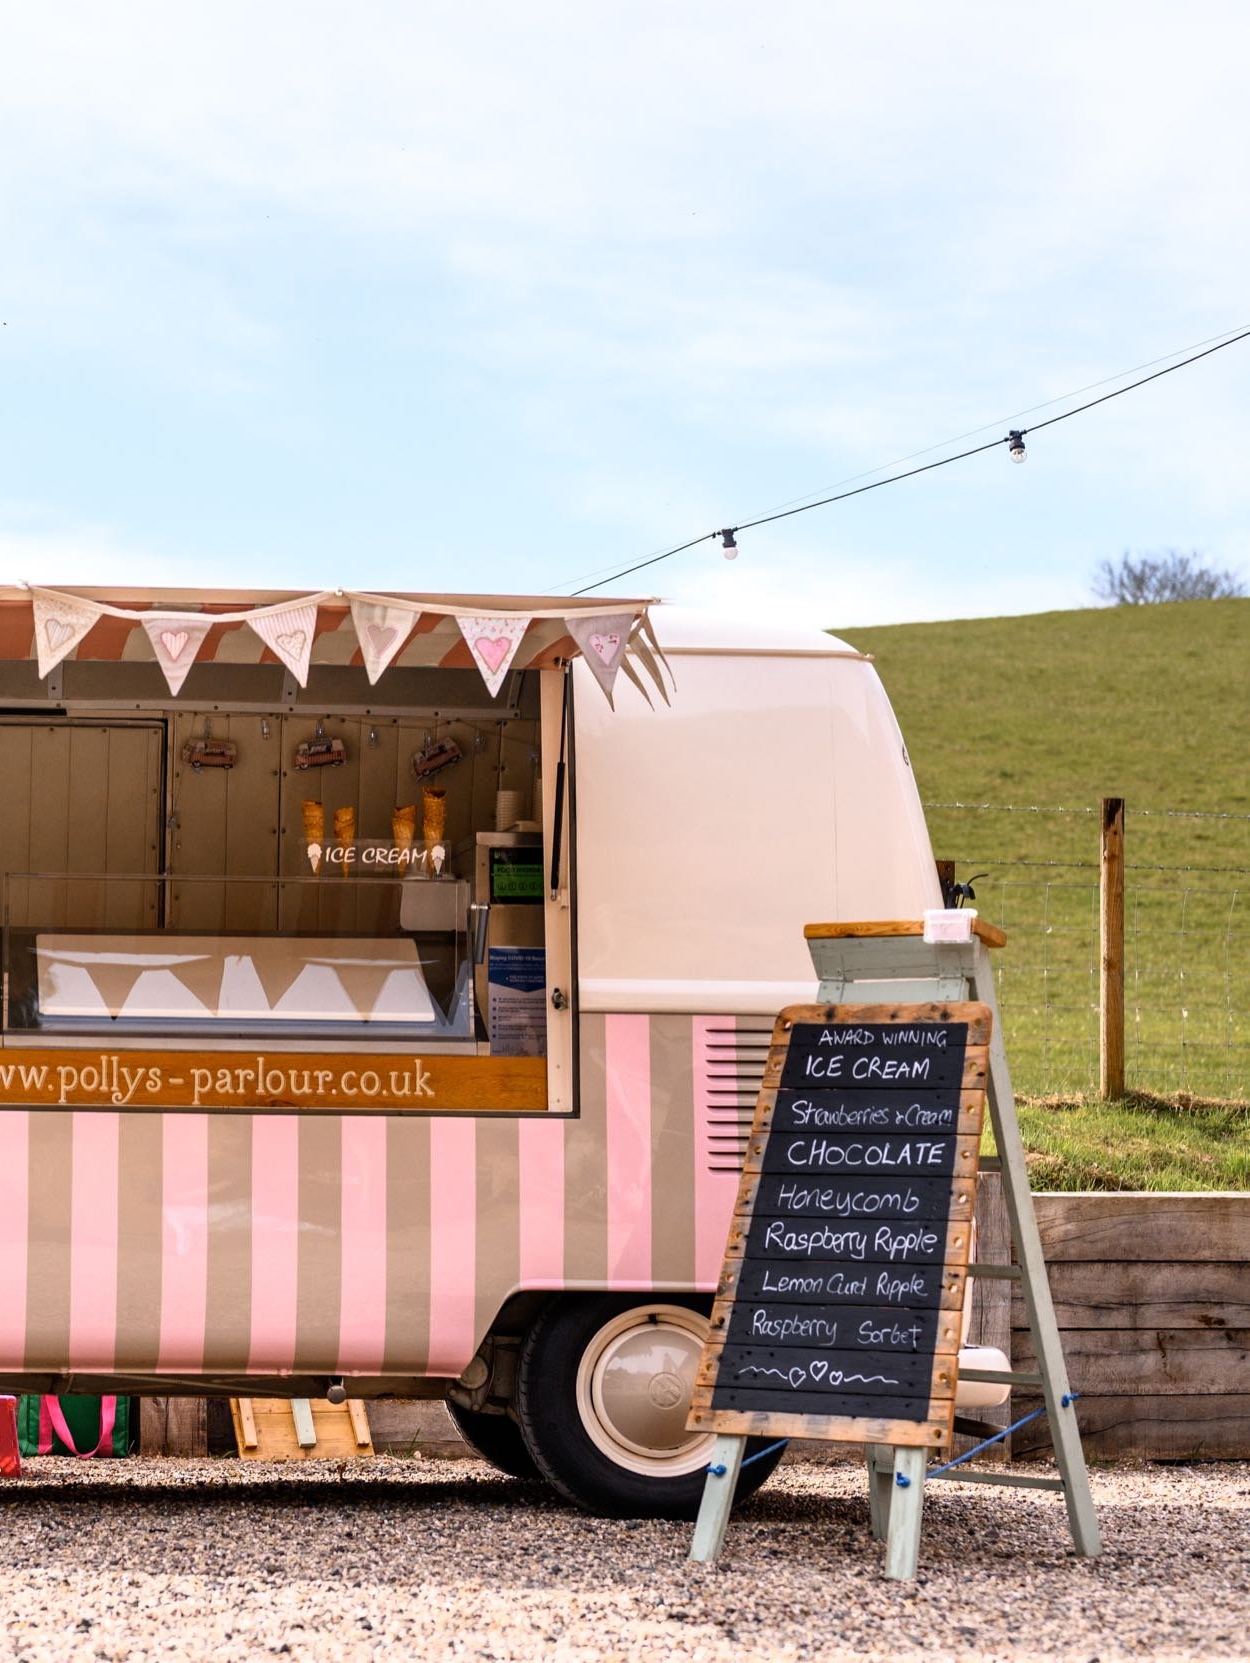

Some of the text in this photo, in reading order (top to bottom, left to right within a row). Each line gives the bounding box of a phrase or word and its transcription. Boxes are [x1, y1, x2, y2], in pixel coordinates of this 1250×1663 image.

[325, 847, 428, 865] ICE CREAM
[818, 1029, 947, 1047] AWARD WINNING
[805, 1054, 930, 1080] ICE CREAM
[791, 1100, 890, 1126] Strawberries
[905, 1104, 953, 1127] Cream
[787, 1138, 946, 1166] CHOCOLATE
[777, 1183, 920, 1217] Honeycomb
[764, 1221, 938, 1260] Raspberry Ripple
[762, 1270, 928, 1302] Lemon Curd Ripple
[752, 1309, 923, 1348] Raspberry Sorbet
